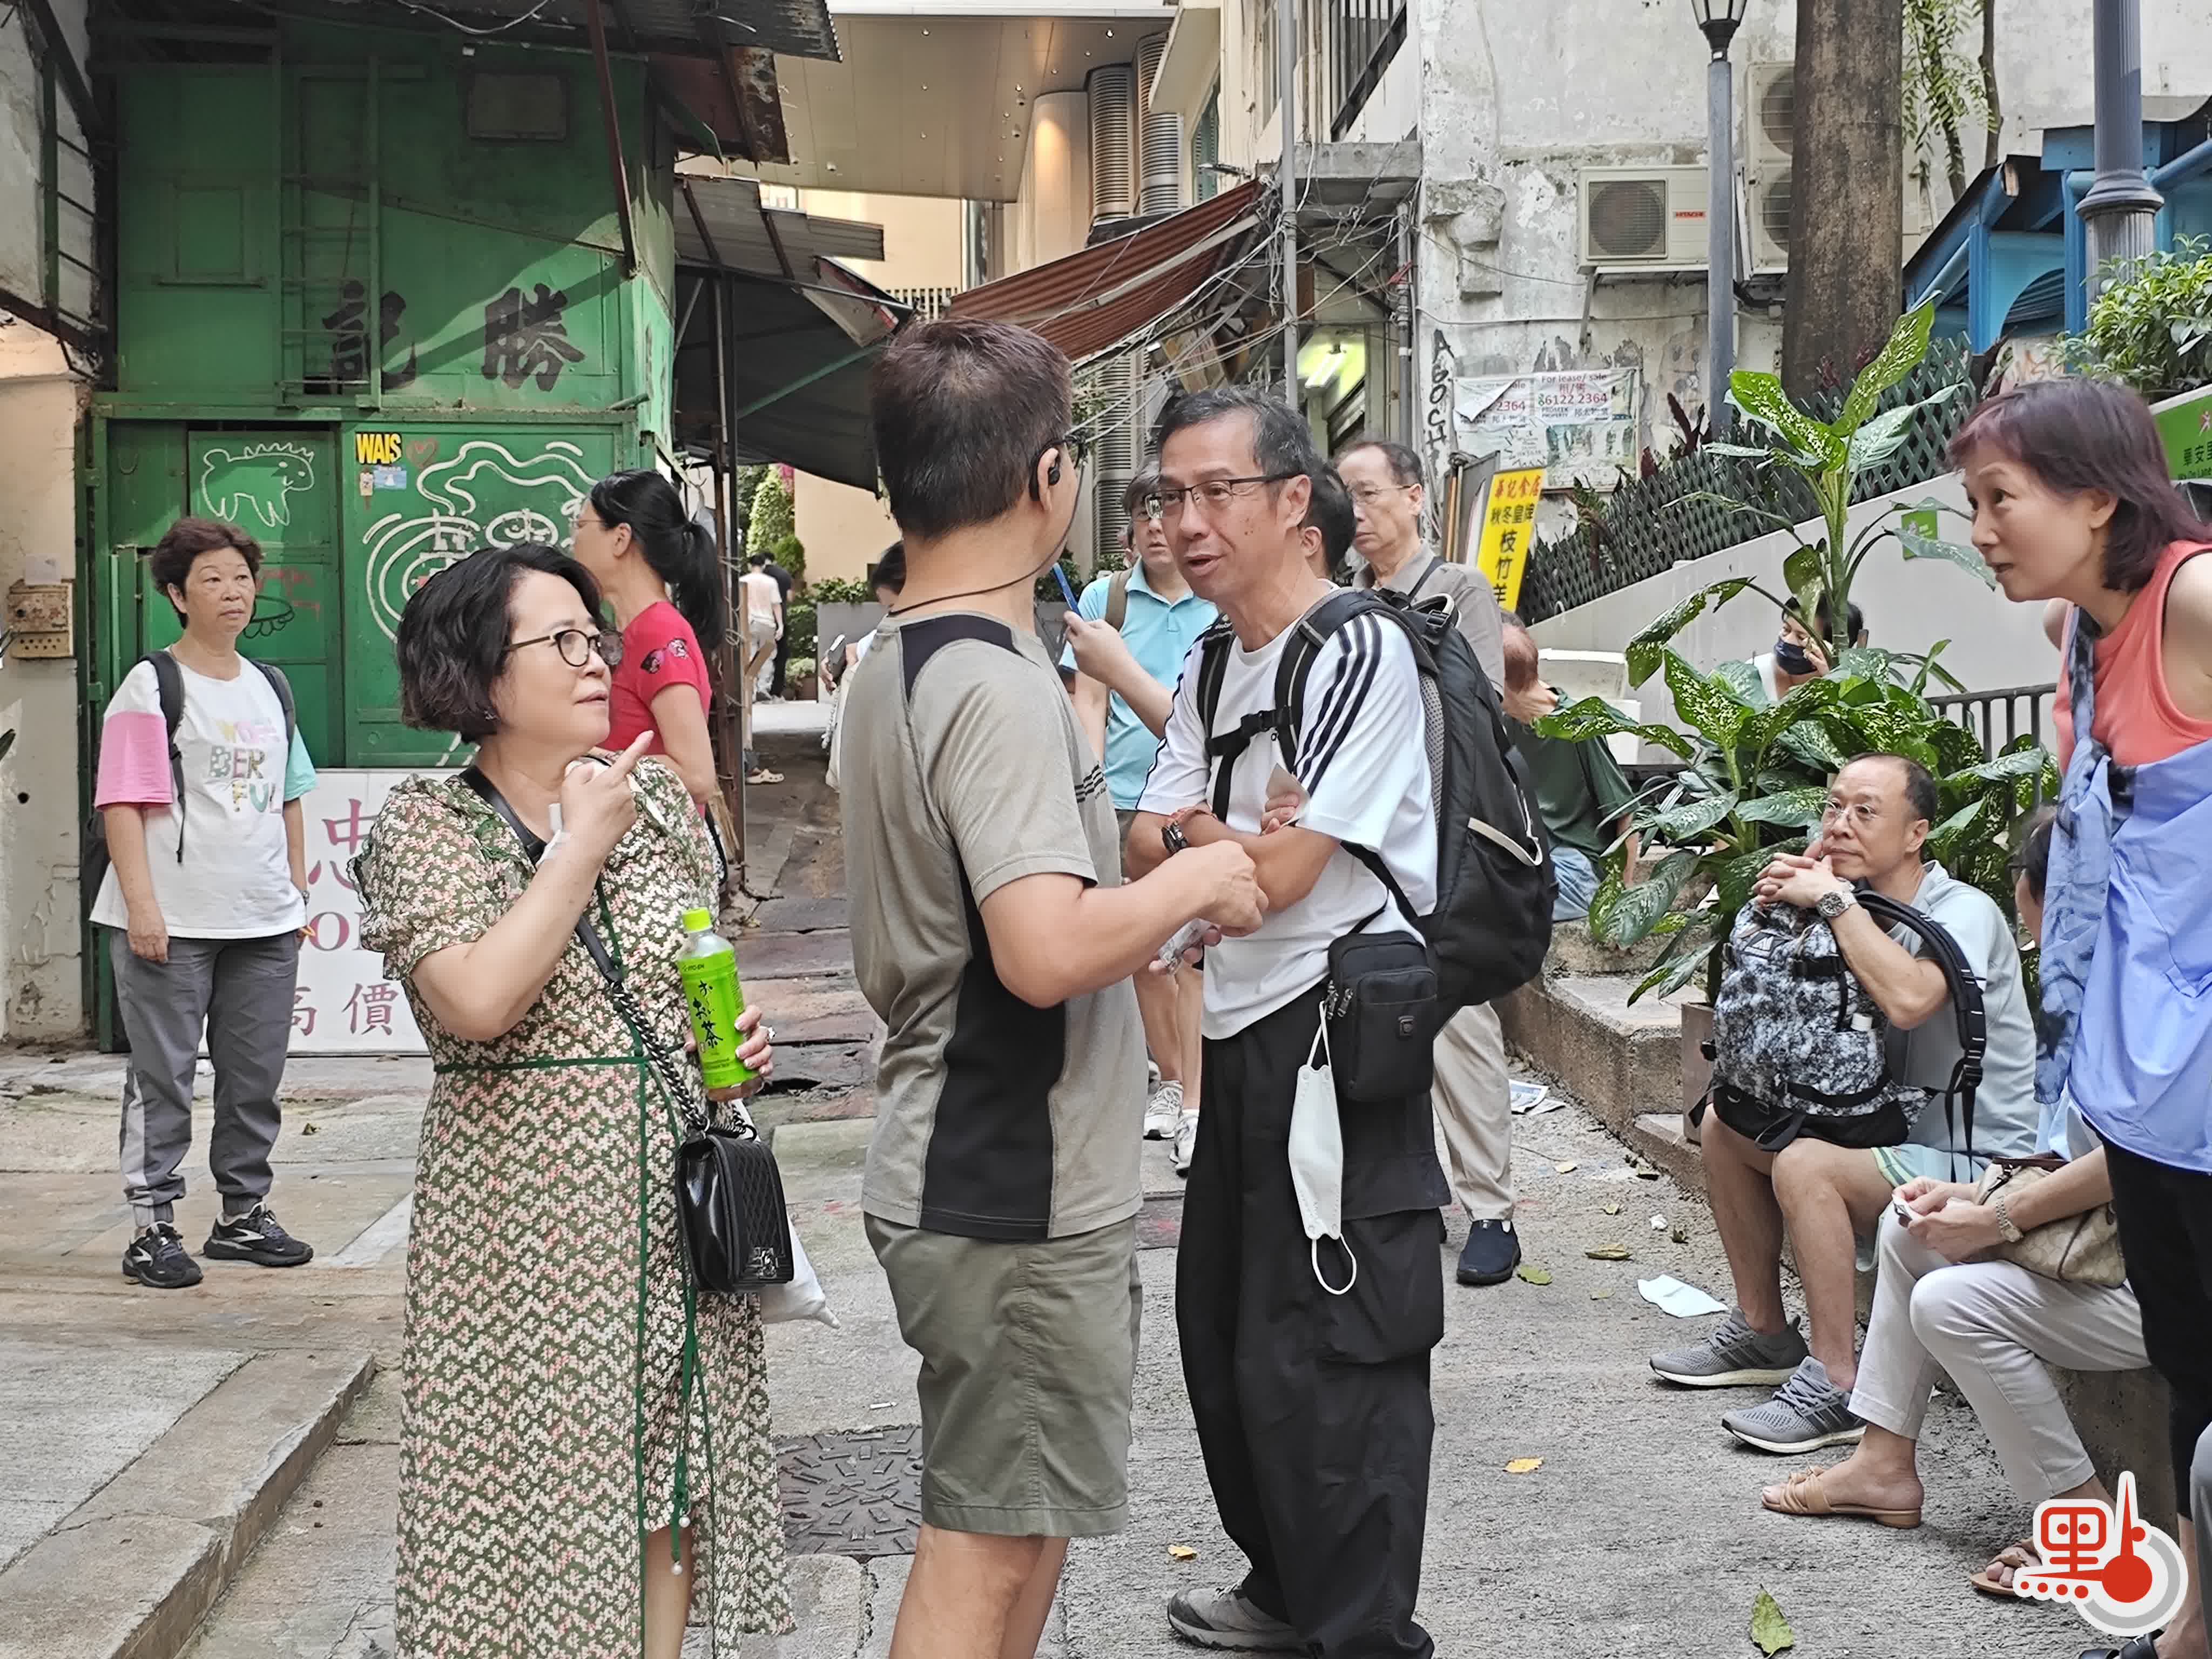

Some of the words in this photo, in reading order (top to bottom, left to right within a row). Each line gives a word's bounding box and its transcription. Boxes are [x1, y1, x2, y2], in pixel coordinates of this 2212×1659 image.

[1542, 375, 1555, 383] For
[1589, 373, 1608, 381] sale
[1545, 394, 1574, 406] 6122
[1577, 393, 1608, 404] 2364
[1494, 401, 1526, 411] 2364
[356, 433, 402, 465] WAIS
